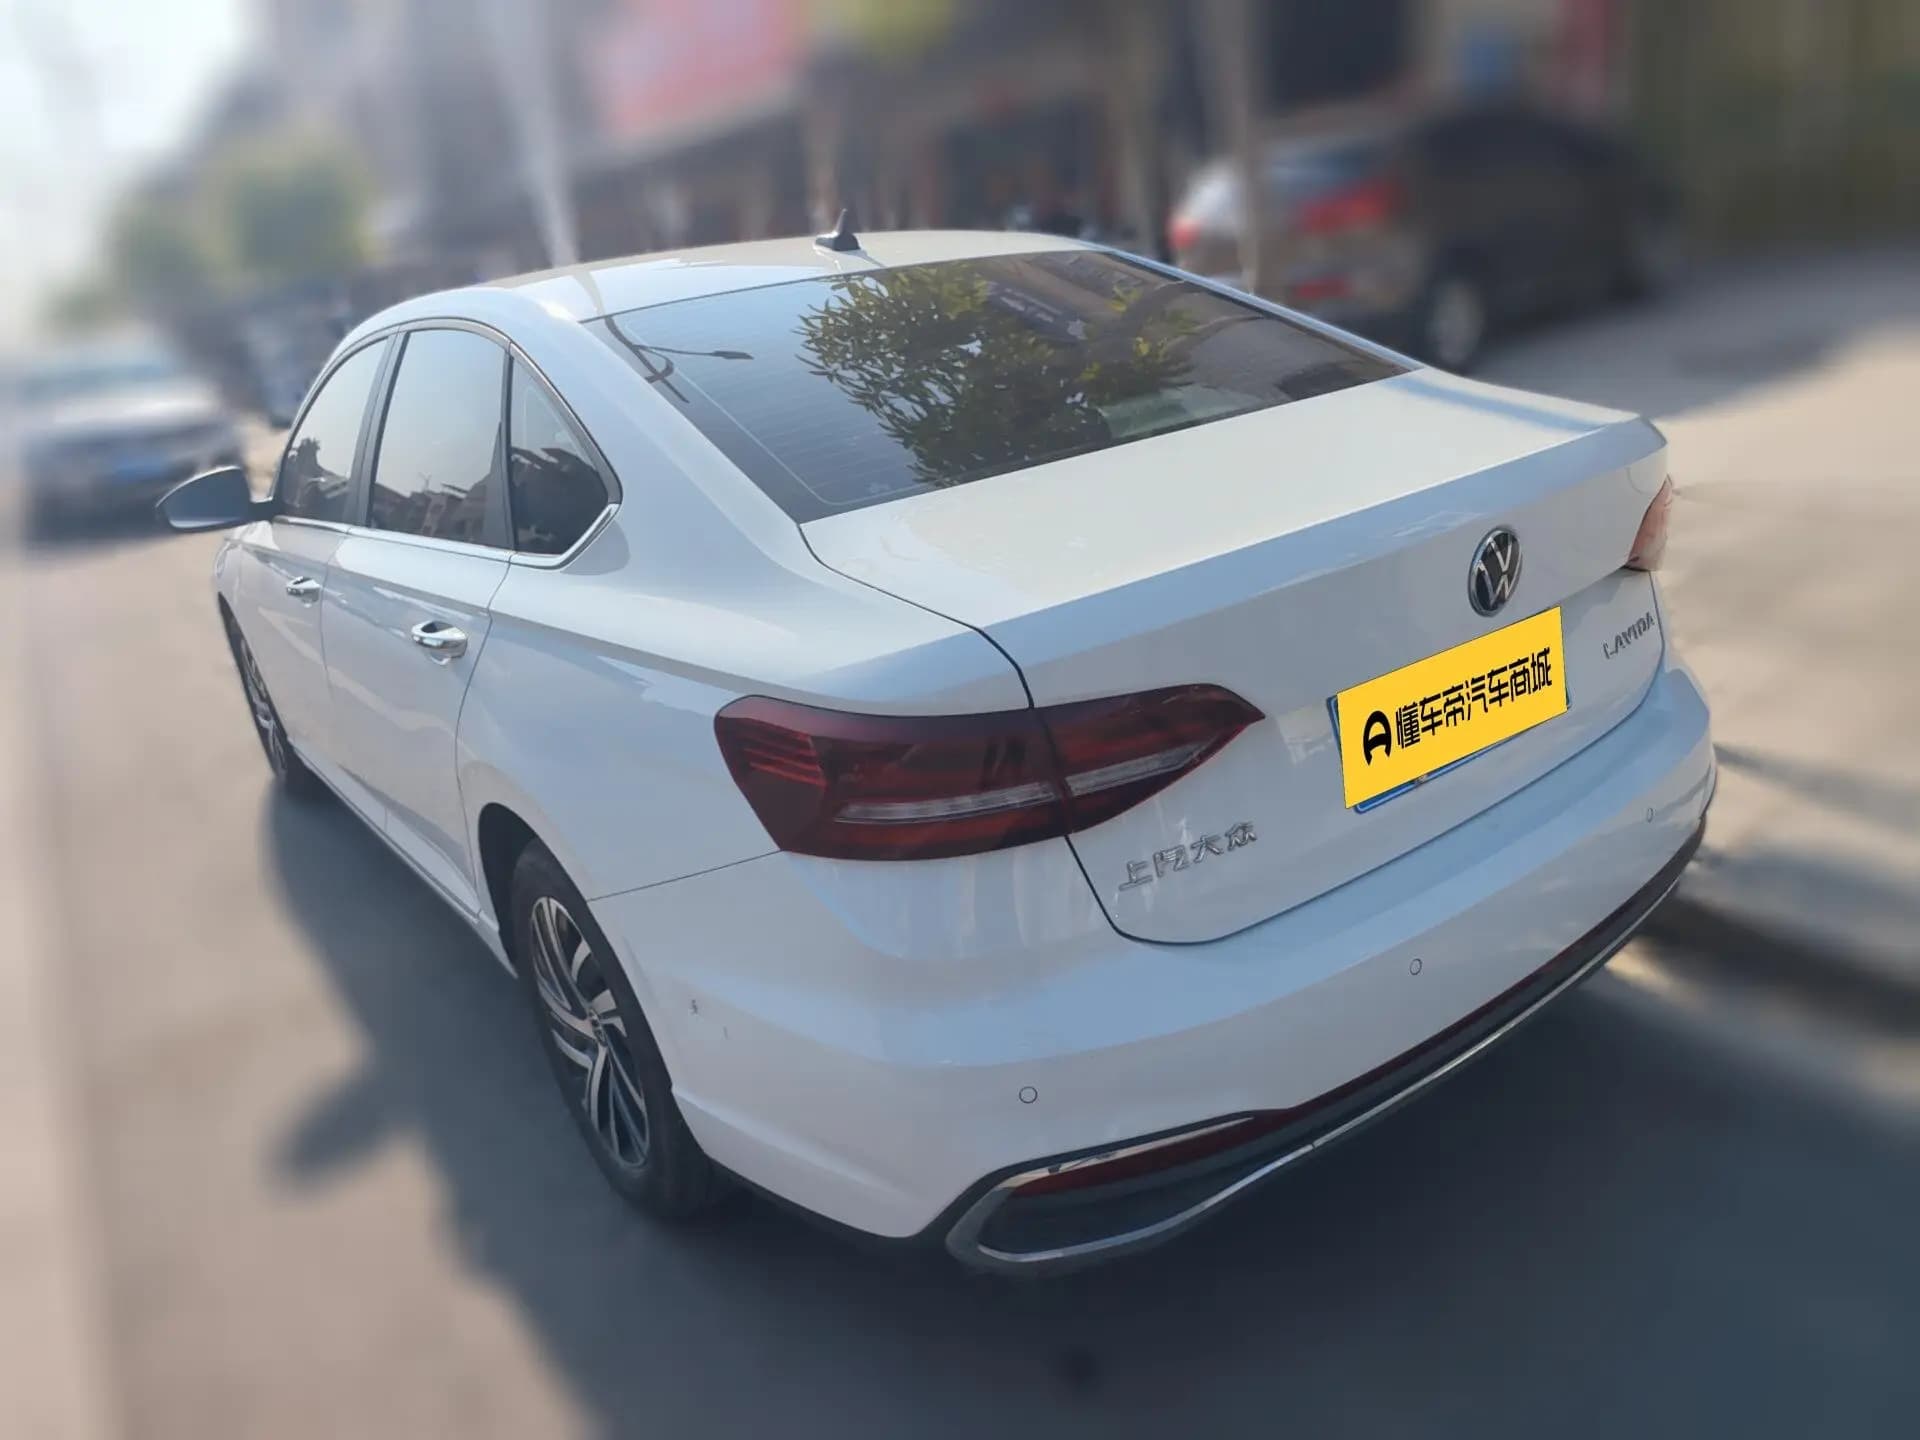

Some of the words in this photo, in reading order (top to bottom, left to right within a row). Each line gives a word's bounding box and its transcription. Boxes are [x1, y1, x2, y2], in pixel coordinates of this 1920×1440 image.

[1603, 611, 1655, 660] LAVIDA
[1118, 820, 1258, 891] 上汽大众
